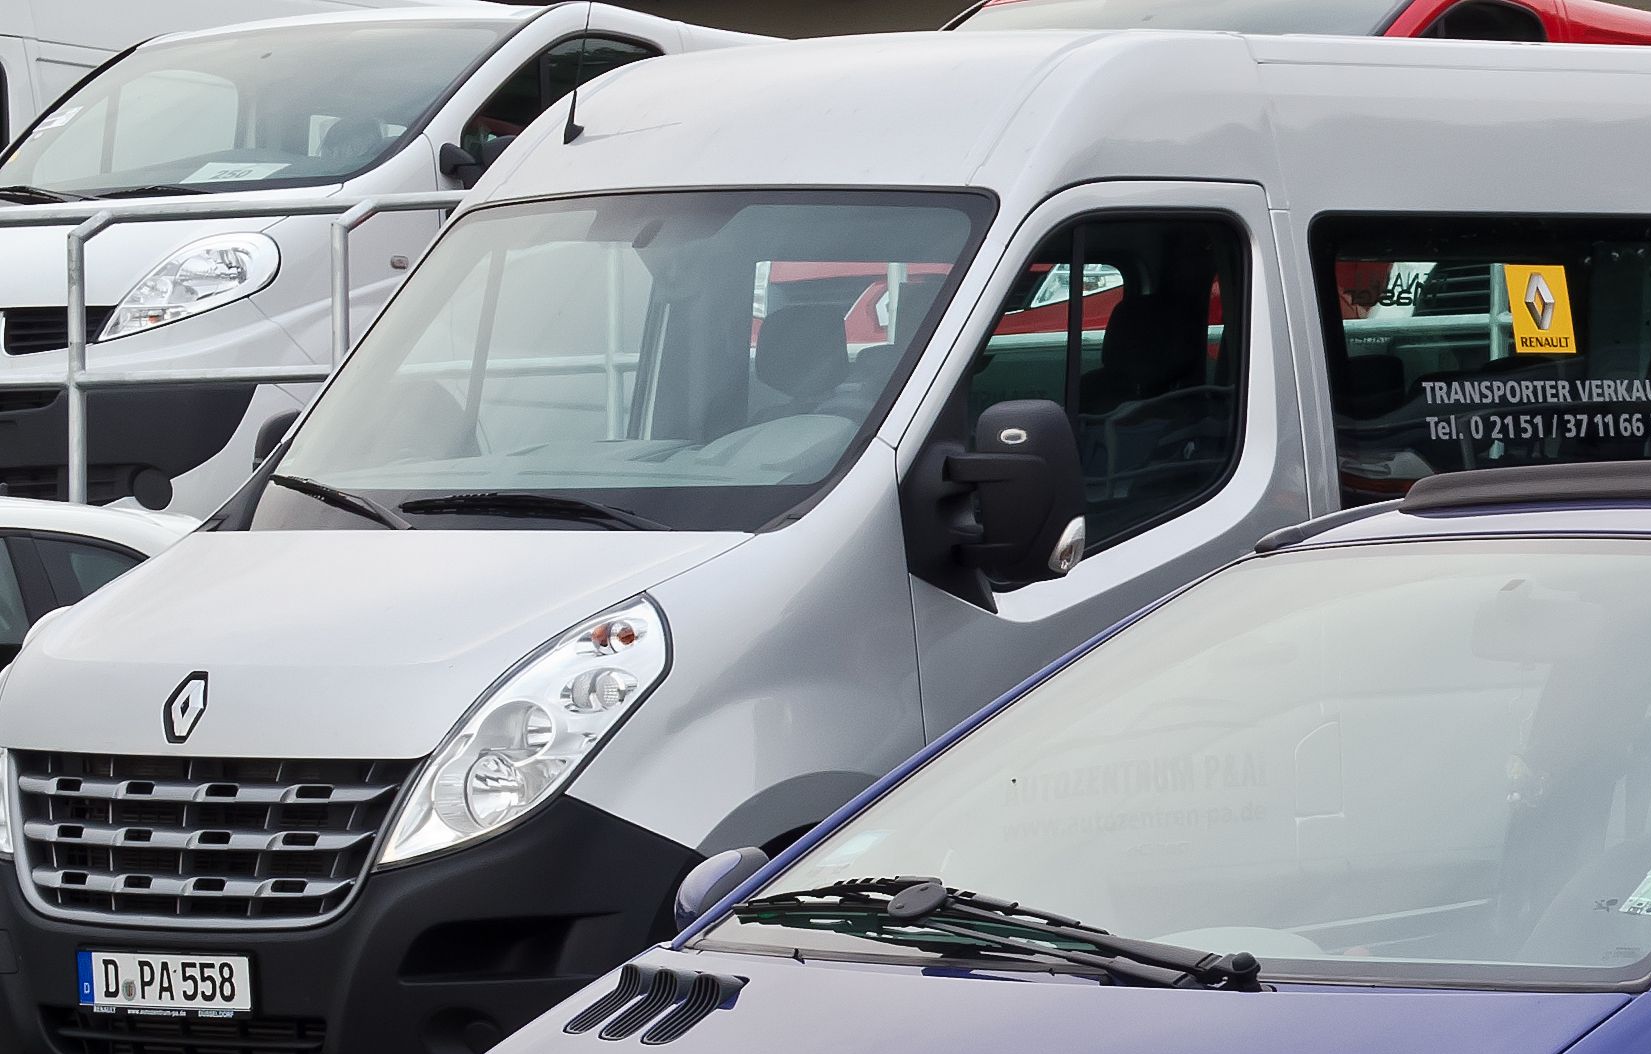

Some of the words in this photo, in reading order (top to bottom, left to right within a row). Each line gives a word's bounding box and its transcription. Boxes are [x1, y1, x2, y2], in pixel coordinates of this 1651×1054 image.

[1521, 337, 1569, 348] RENAULT
[1422, 381, 1570, 404] TRANSPORTER
[1426, 415, 1464, 440] Tel.
[83, 983, 90, 994] D
[102, 959, 120, 998] D
[181, 961, 236, 1003] 558
